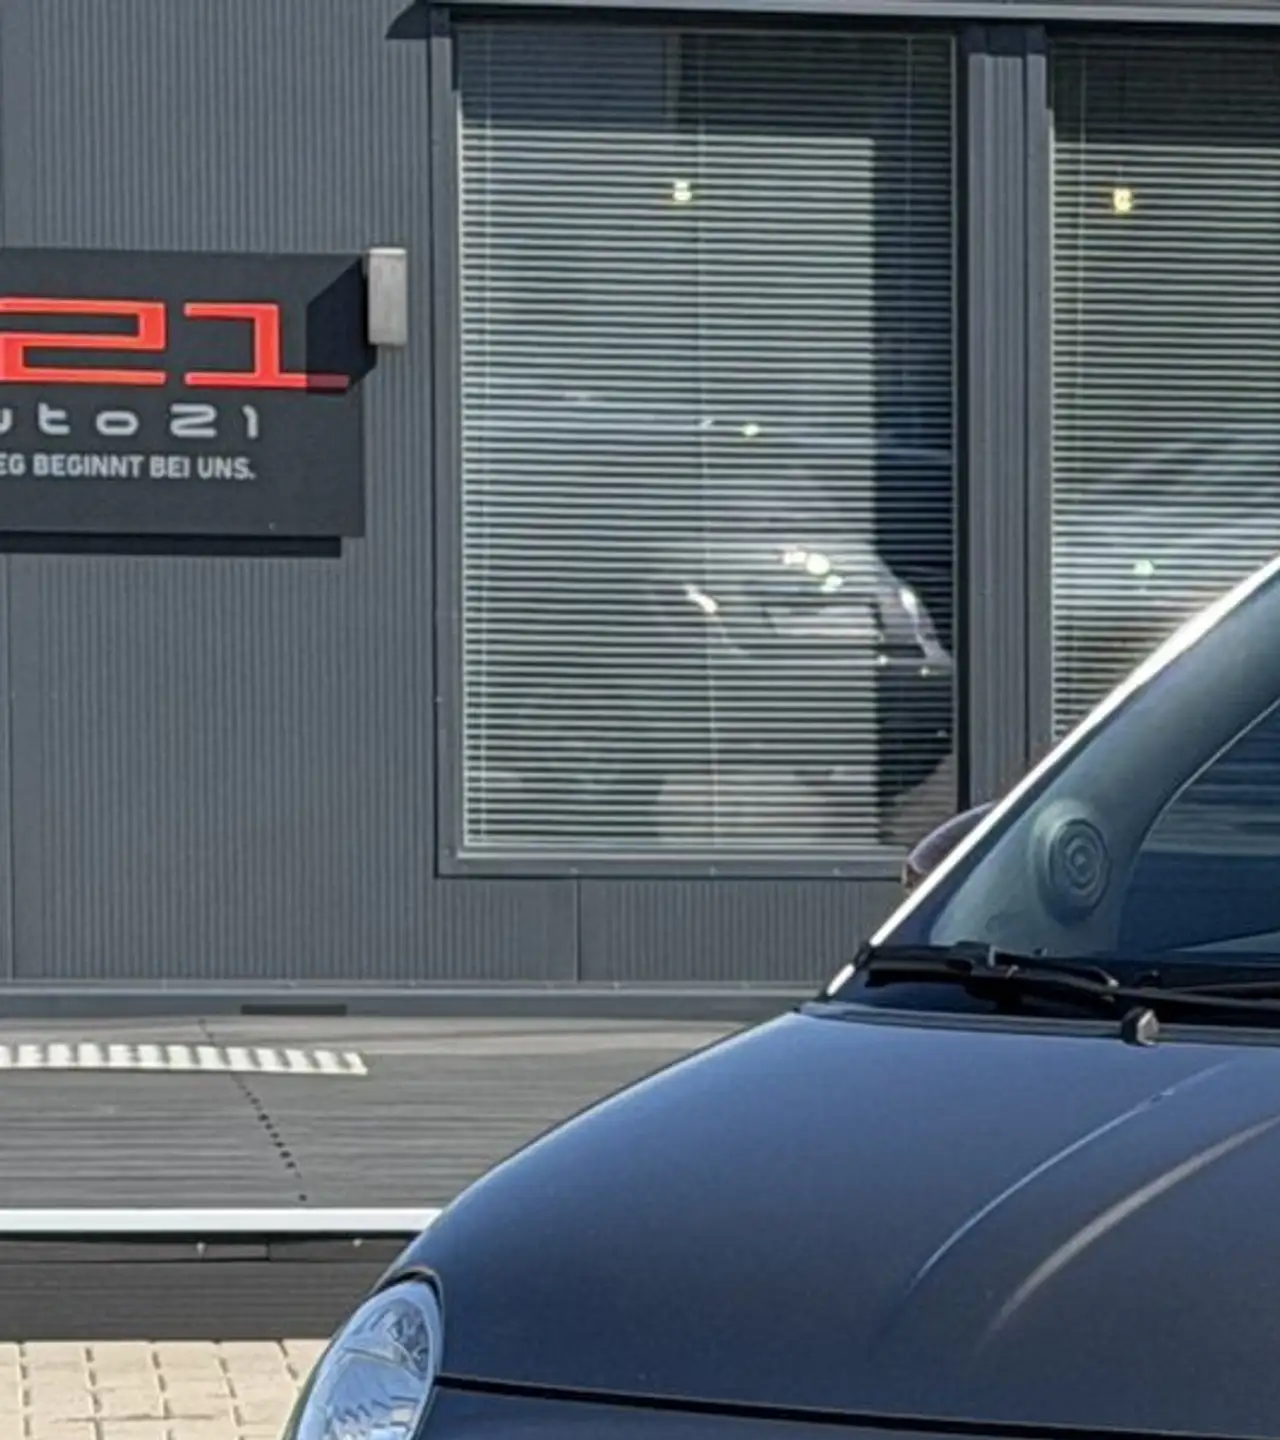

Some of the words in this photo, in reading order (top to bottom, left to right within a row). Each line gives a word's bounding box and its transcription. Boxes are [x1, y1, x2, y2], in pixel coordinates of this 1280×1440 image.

[33, 453, 144, 478] BEGINNT
[150, 455, 191, 478] BEI
[198, 456, 256, 480] UNS.
